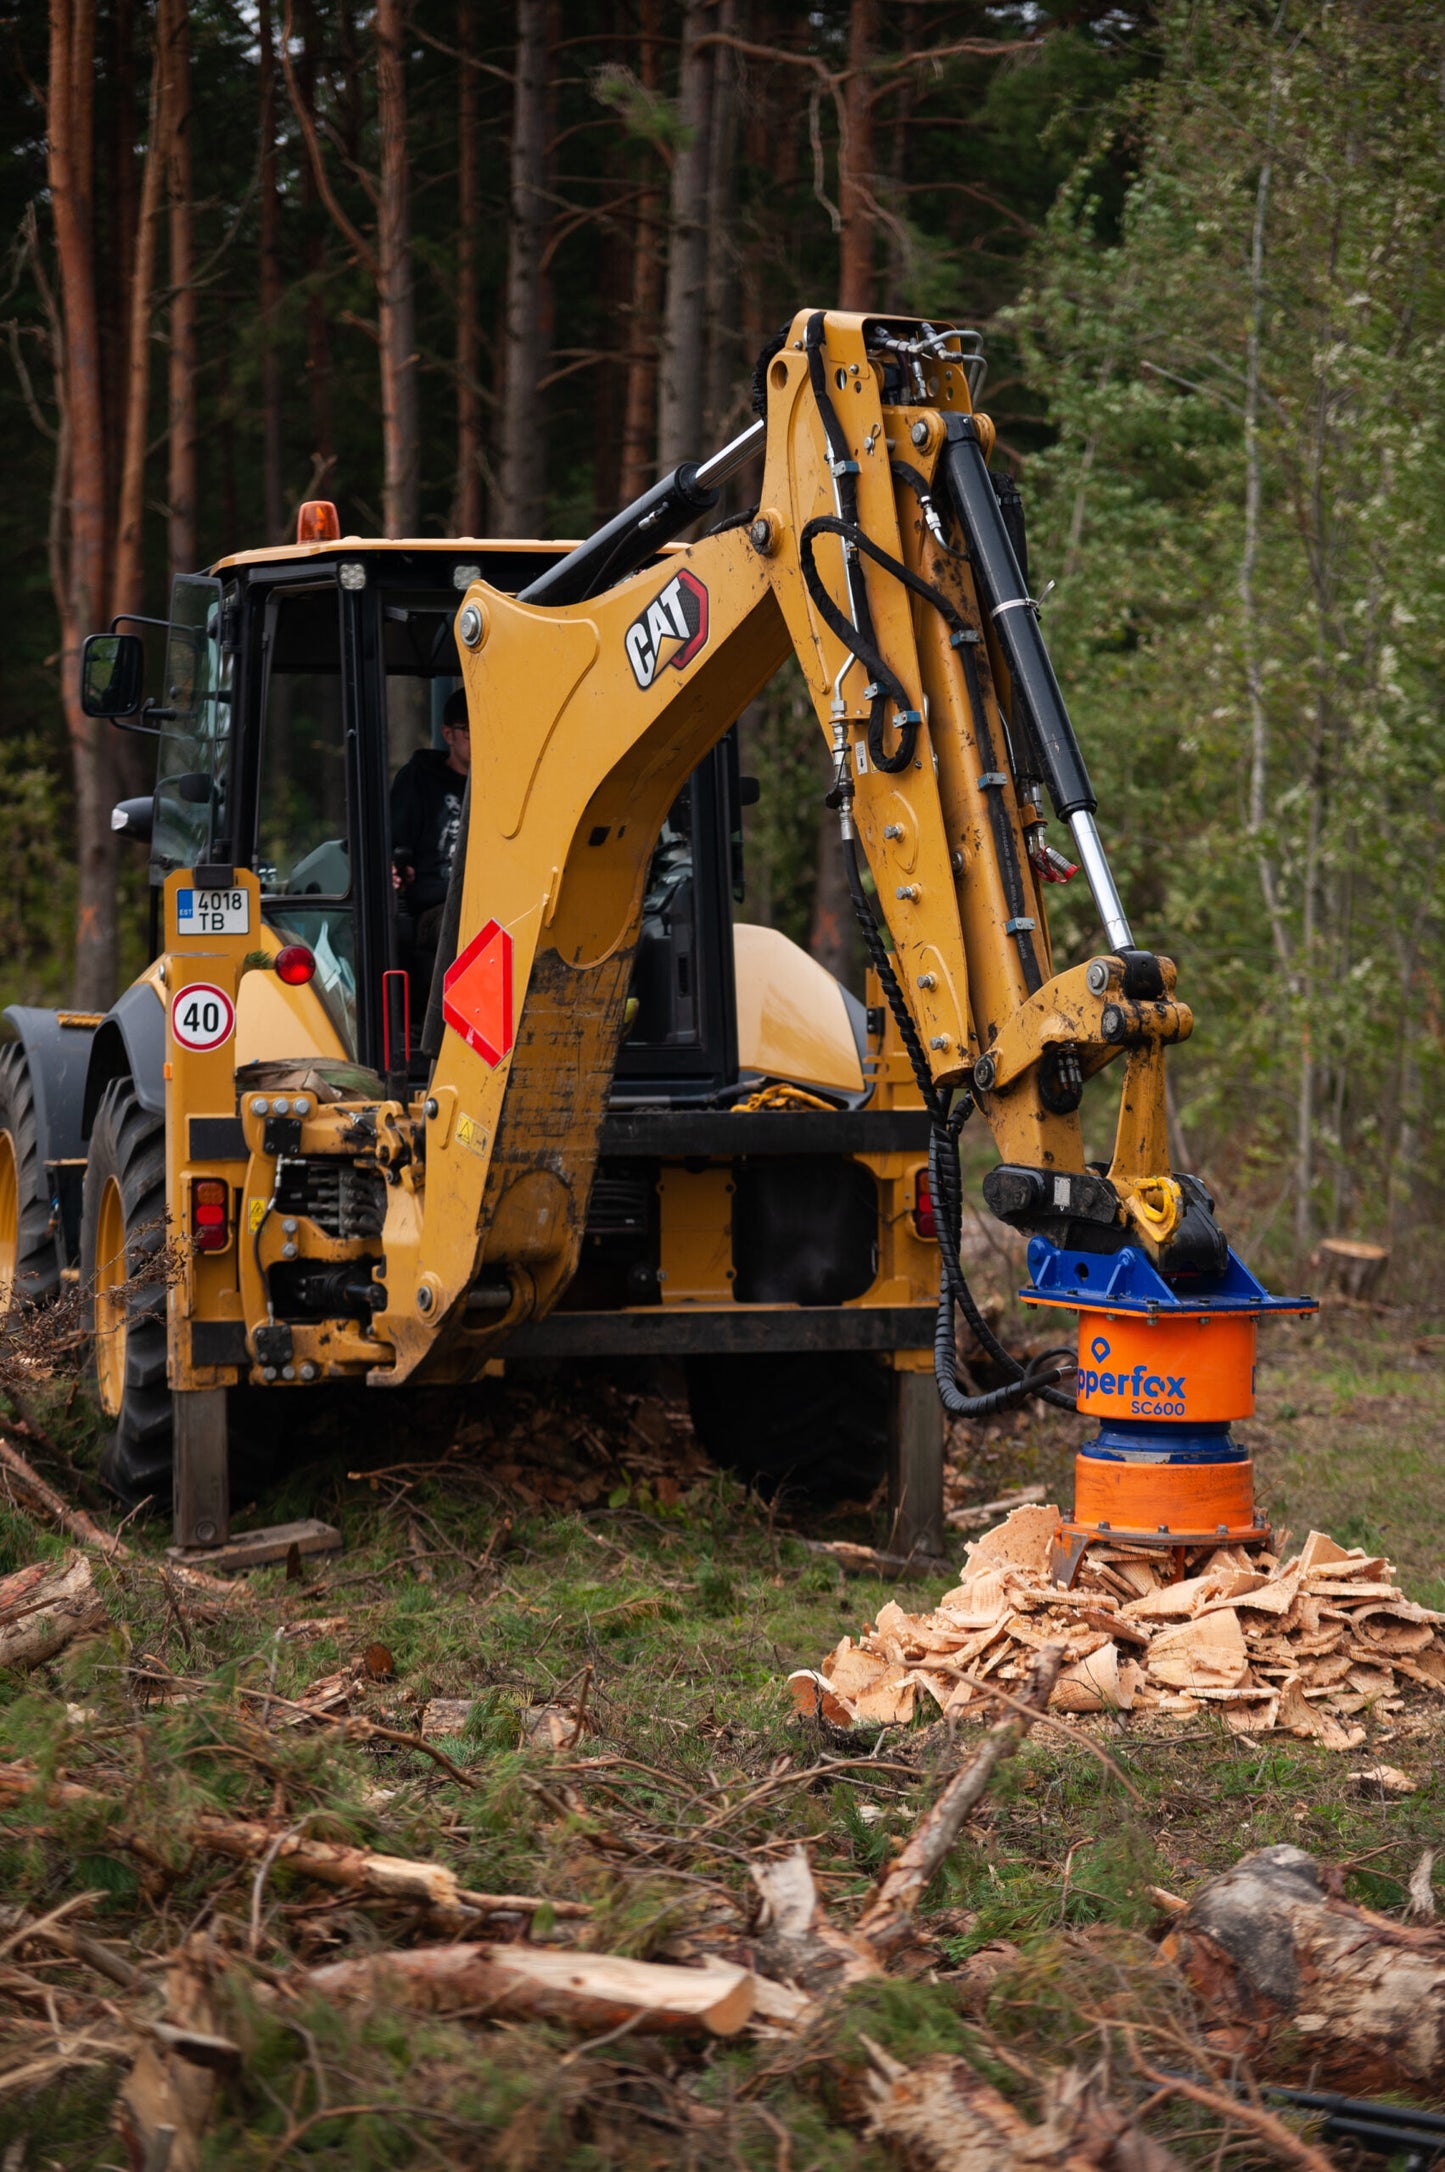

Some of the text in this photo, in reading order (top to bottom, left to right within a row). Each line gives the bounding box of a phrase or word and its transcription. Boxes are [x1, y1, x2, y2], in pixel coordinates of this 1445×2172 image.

[625, 576, 691, 688] CAT
[198, 892, 242, 911] 4018
[199, 912, 225, 931] TB
[183, 1002, 219, 1033] 40
[1131, 1400, 1185, 1417] SC600
